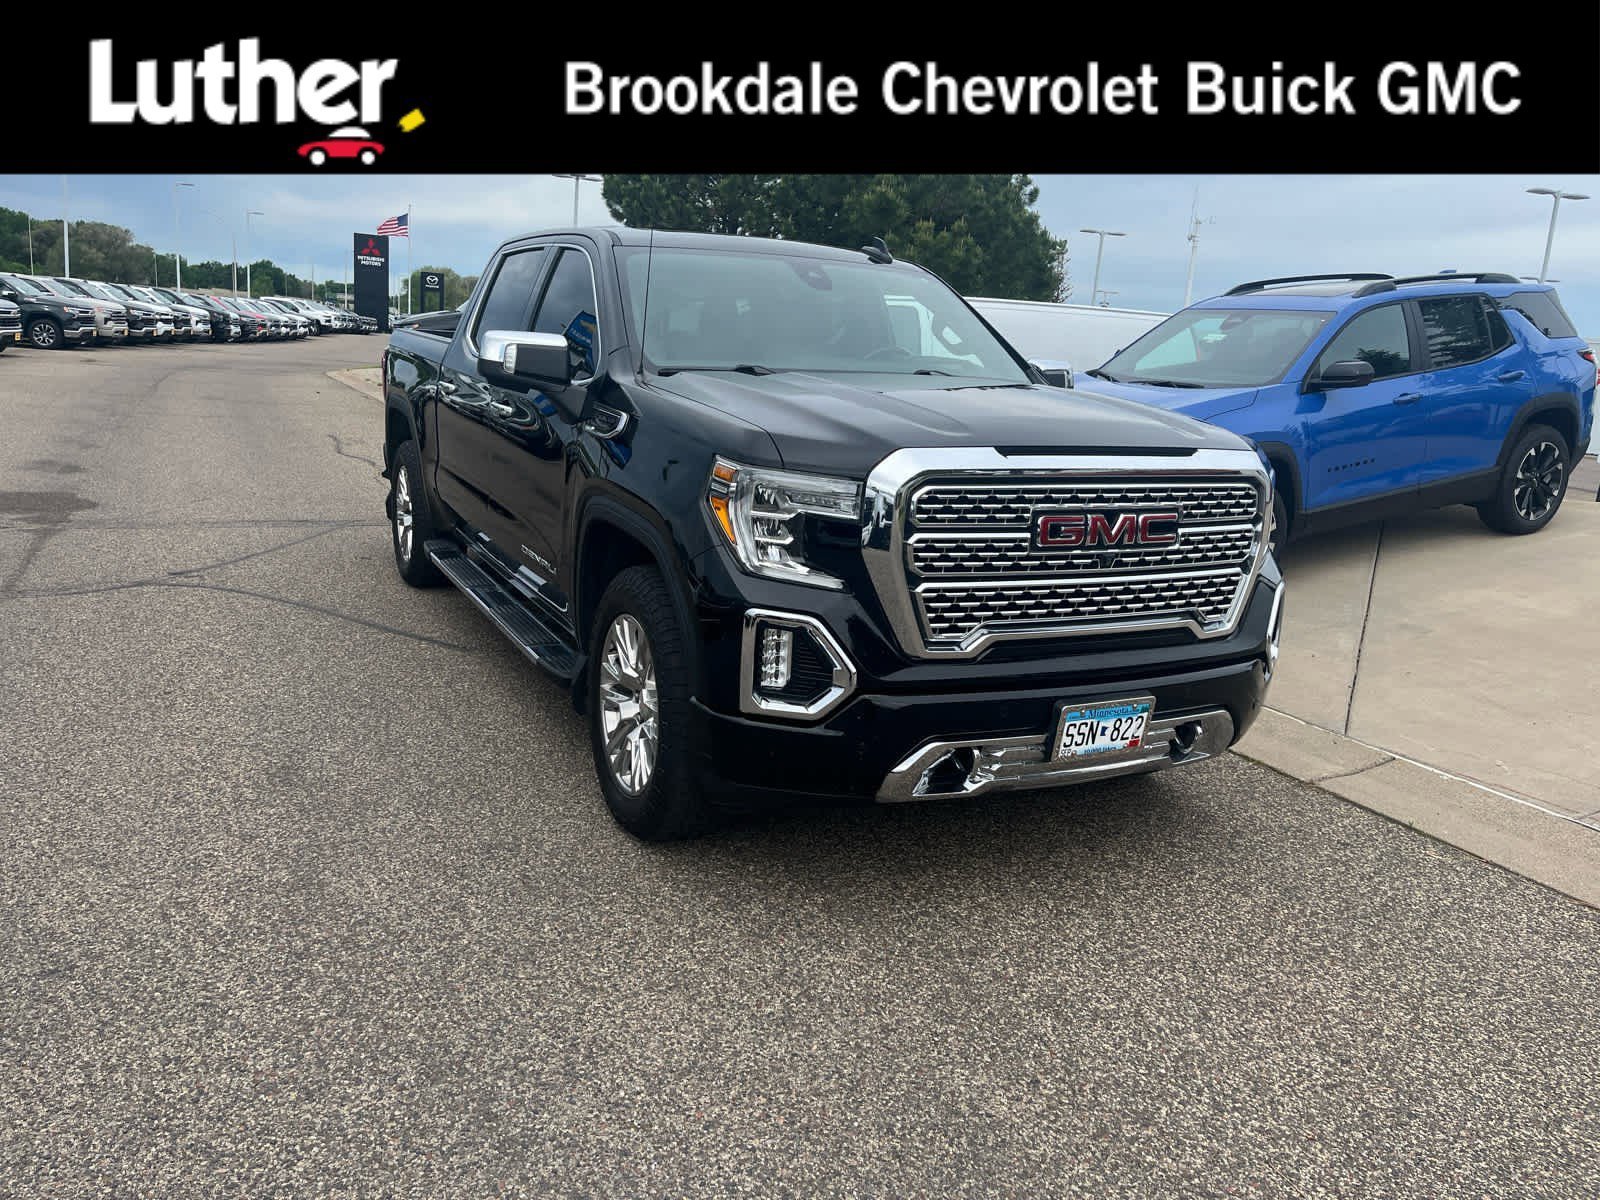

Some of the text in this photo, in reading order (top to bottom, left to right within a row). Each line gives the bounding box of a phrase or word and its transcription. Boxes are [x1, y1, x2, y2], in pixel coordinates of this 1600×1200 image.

[1038, 513, 1178, 547] GMC
[1087, 707, 1130, 720] Minnesota
[1062, 715, 1145, 748] SSN 822
